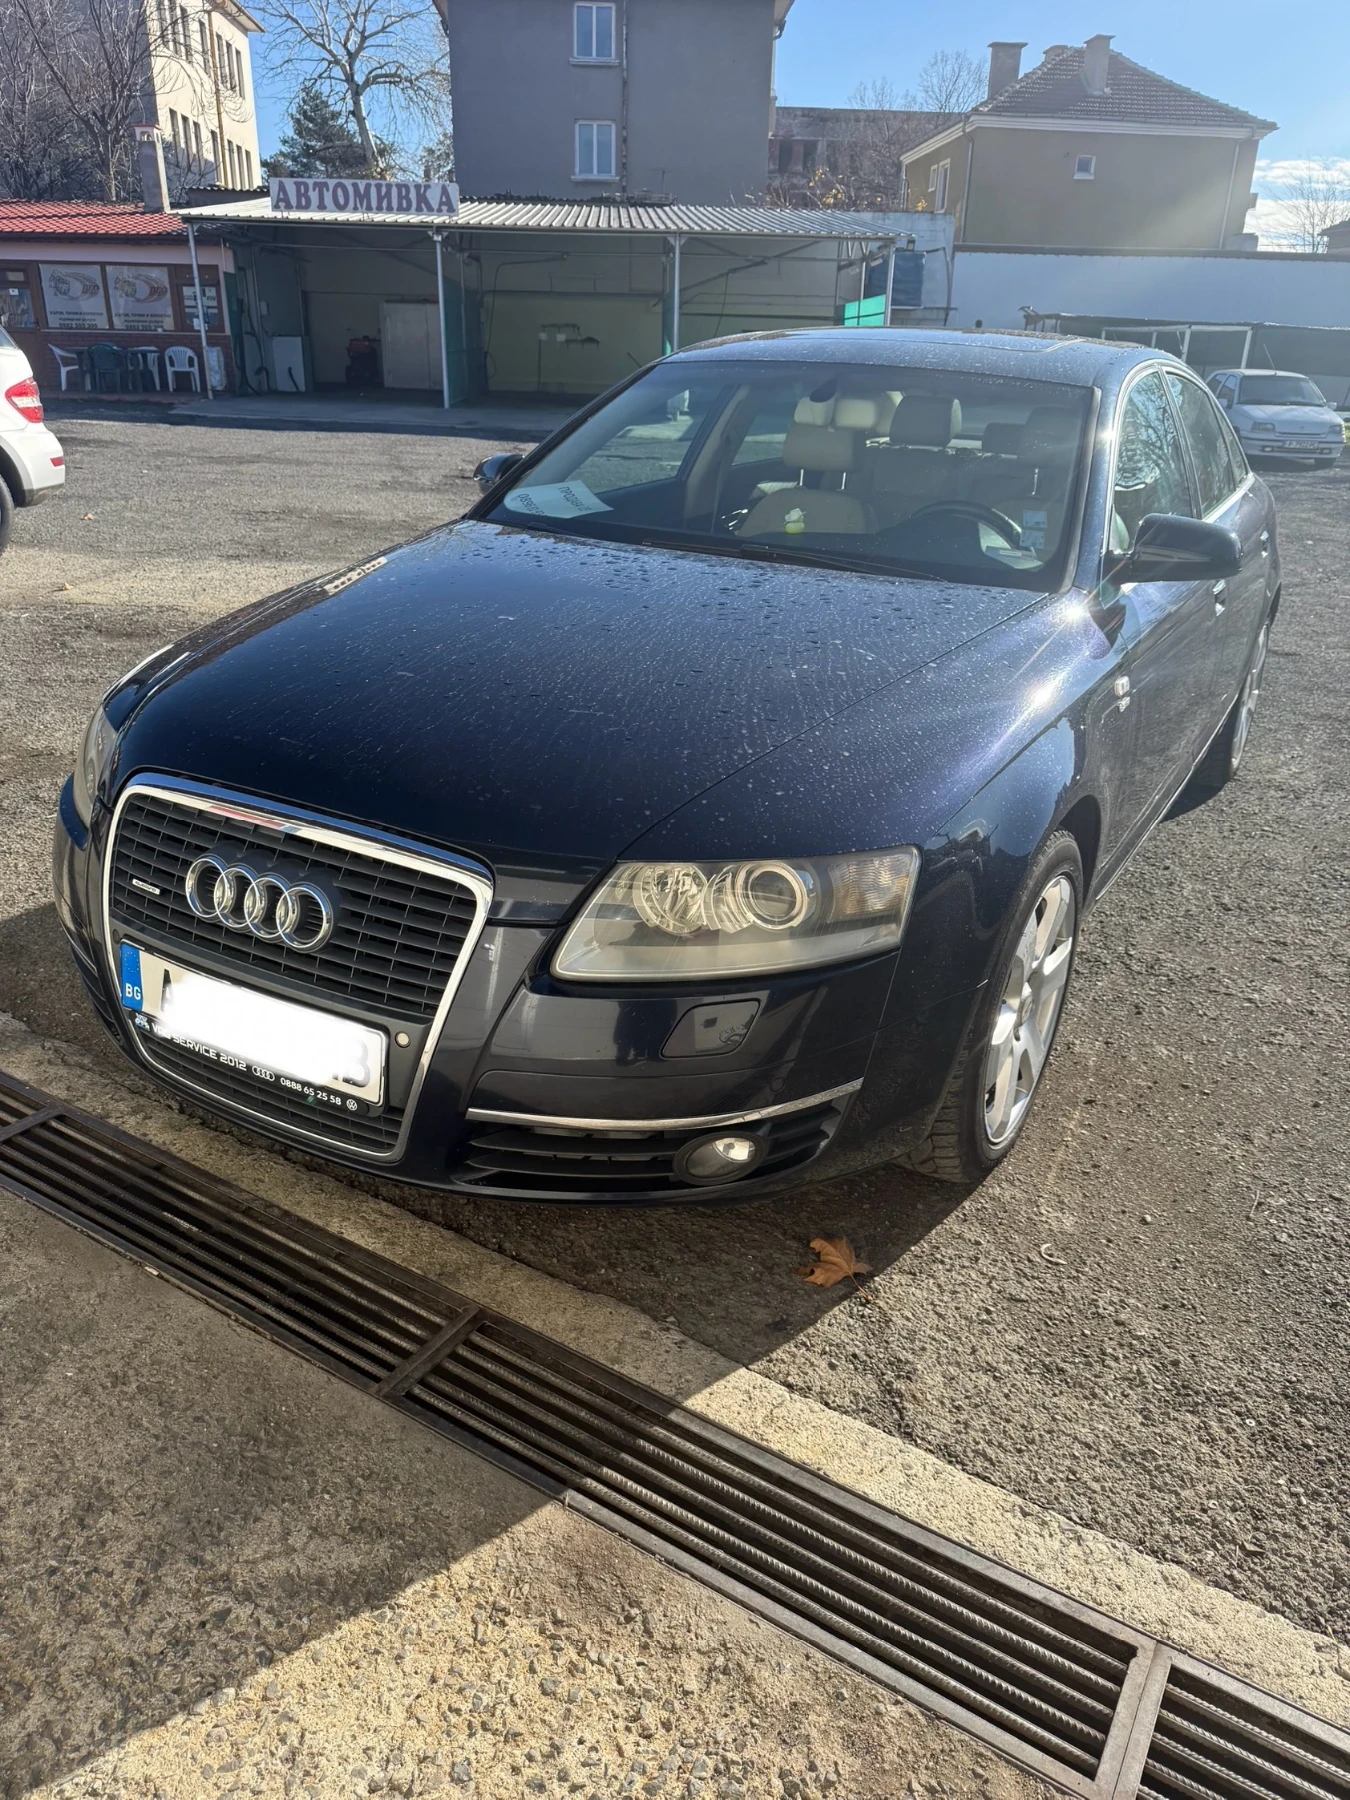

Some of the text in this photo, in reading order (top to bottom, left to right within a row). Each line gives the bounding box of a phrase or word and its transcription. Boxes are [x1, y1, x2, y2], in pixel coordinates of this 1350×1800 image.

[273, 179, 456, 213] АВТОМИВКА
[125, 983, 141, 1000] BG
[172, 1034, 218, 1060] SERVICE
[220, 1053, 247, 1071] 2012
[280, 1077, 302, 1092] 0888
[303, 1086, 315, 1096] 65
[316, 1090, 328, 1101] 25
[329, 1096, 342, 1106] 58
